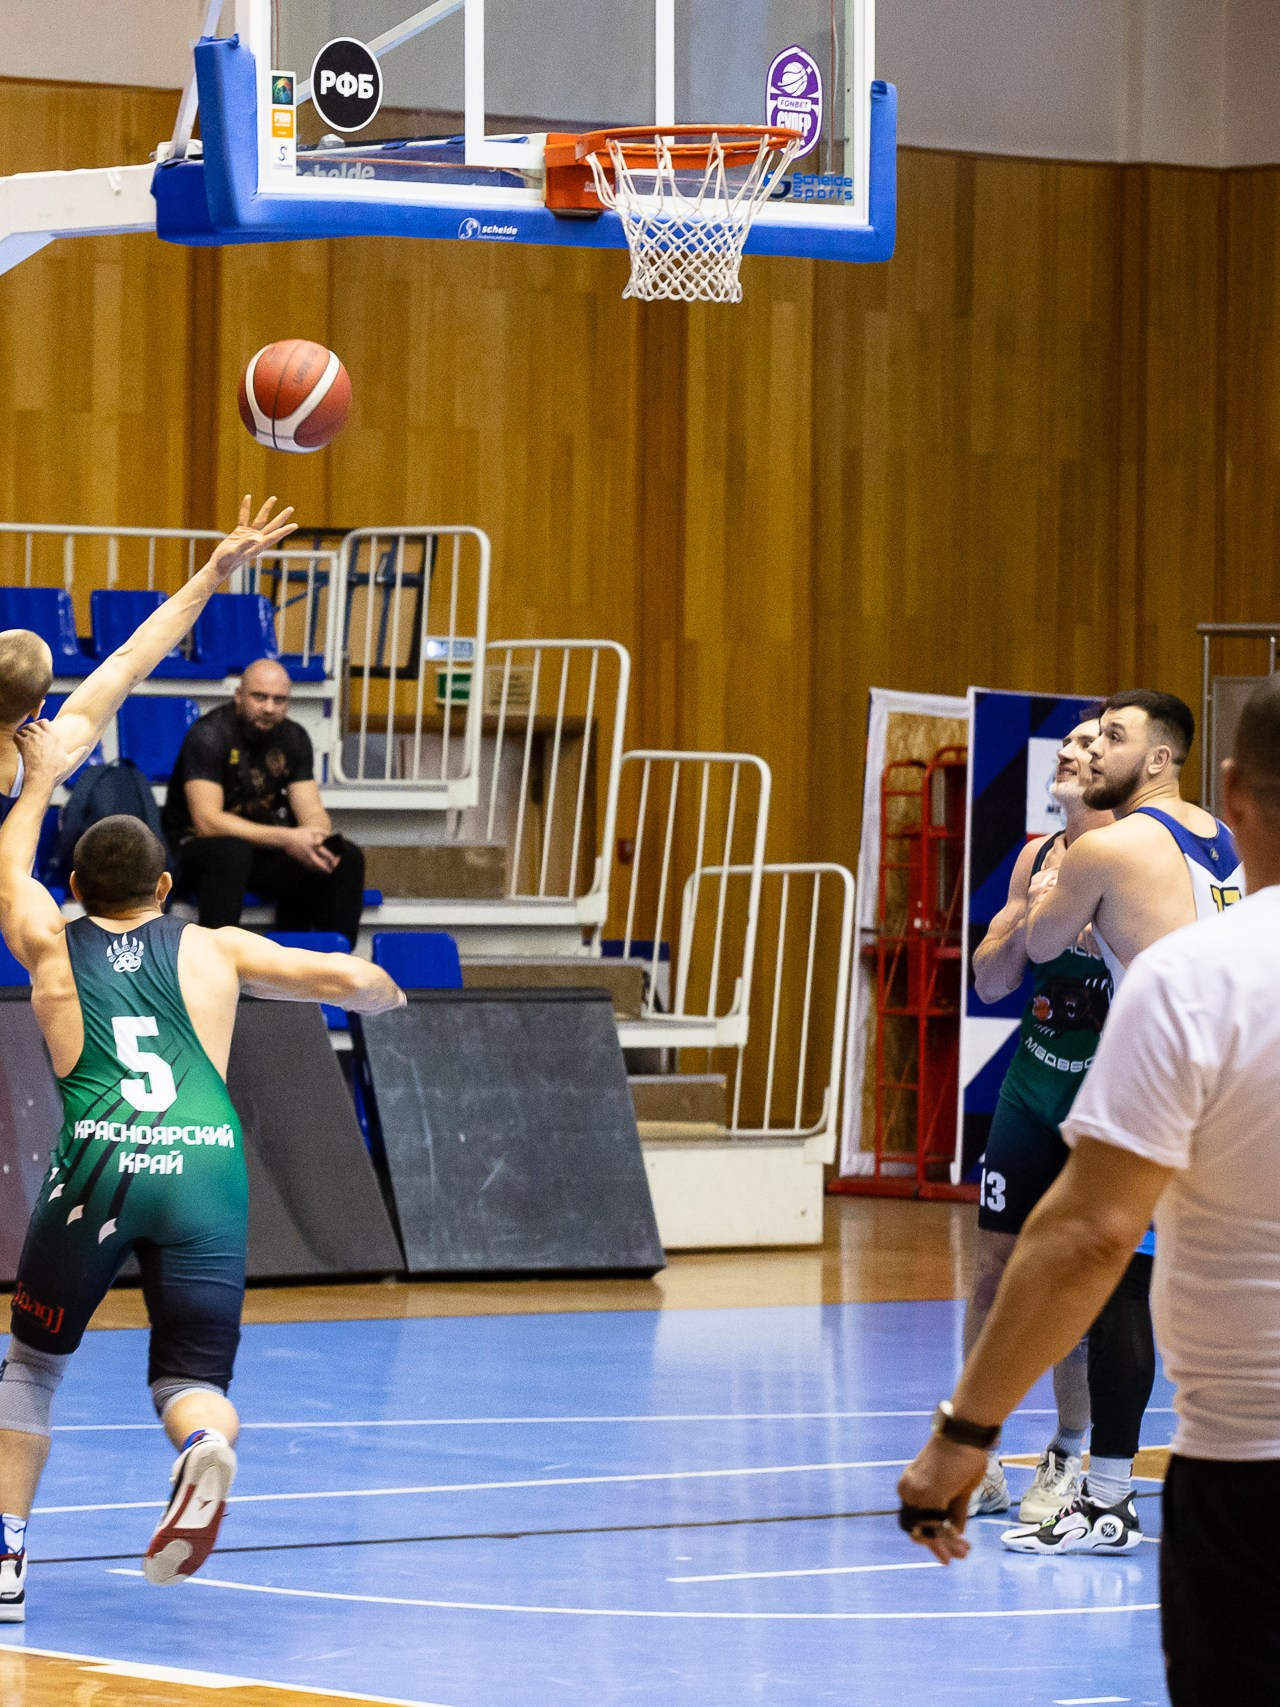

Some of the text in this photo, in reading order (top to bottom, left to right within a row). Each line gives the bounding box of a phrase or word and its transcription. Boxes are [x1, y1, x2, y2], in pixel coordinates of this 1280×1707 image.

[320, 69, 374, 99] РФБ
[780, 100, 808, 109] FONBET
[792, 185, 853, 201] Sports
[111, 1016, 178, 1112] 5
[74, 1119, 235, 1148] КРАСНОЯРСКИЙ
[118, 1150, 184, 1174] КРАЙ
